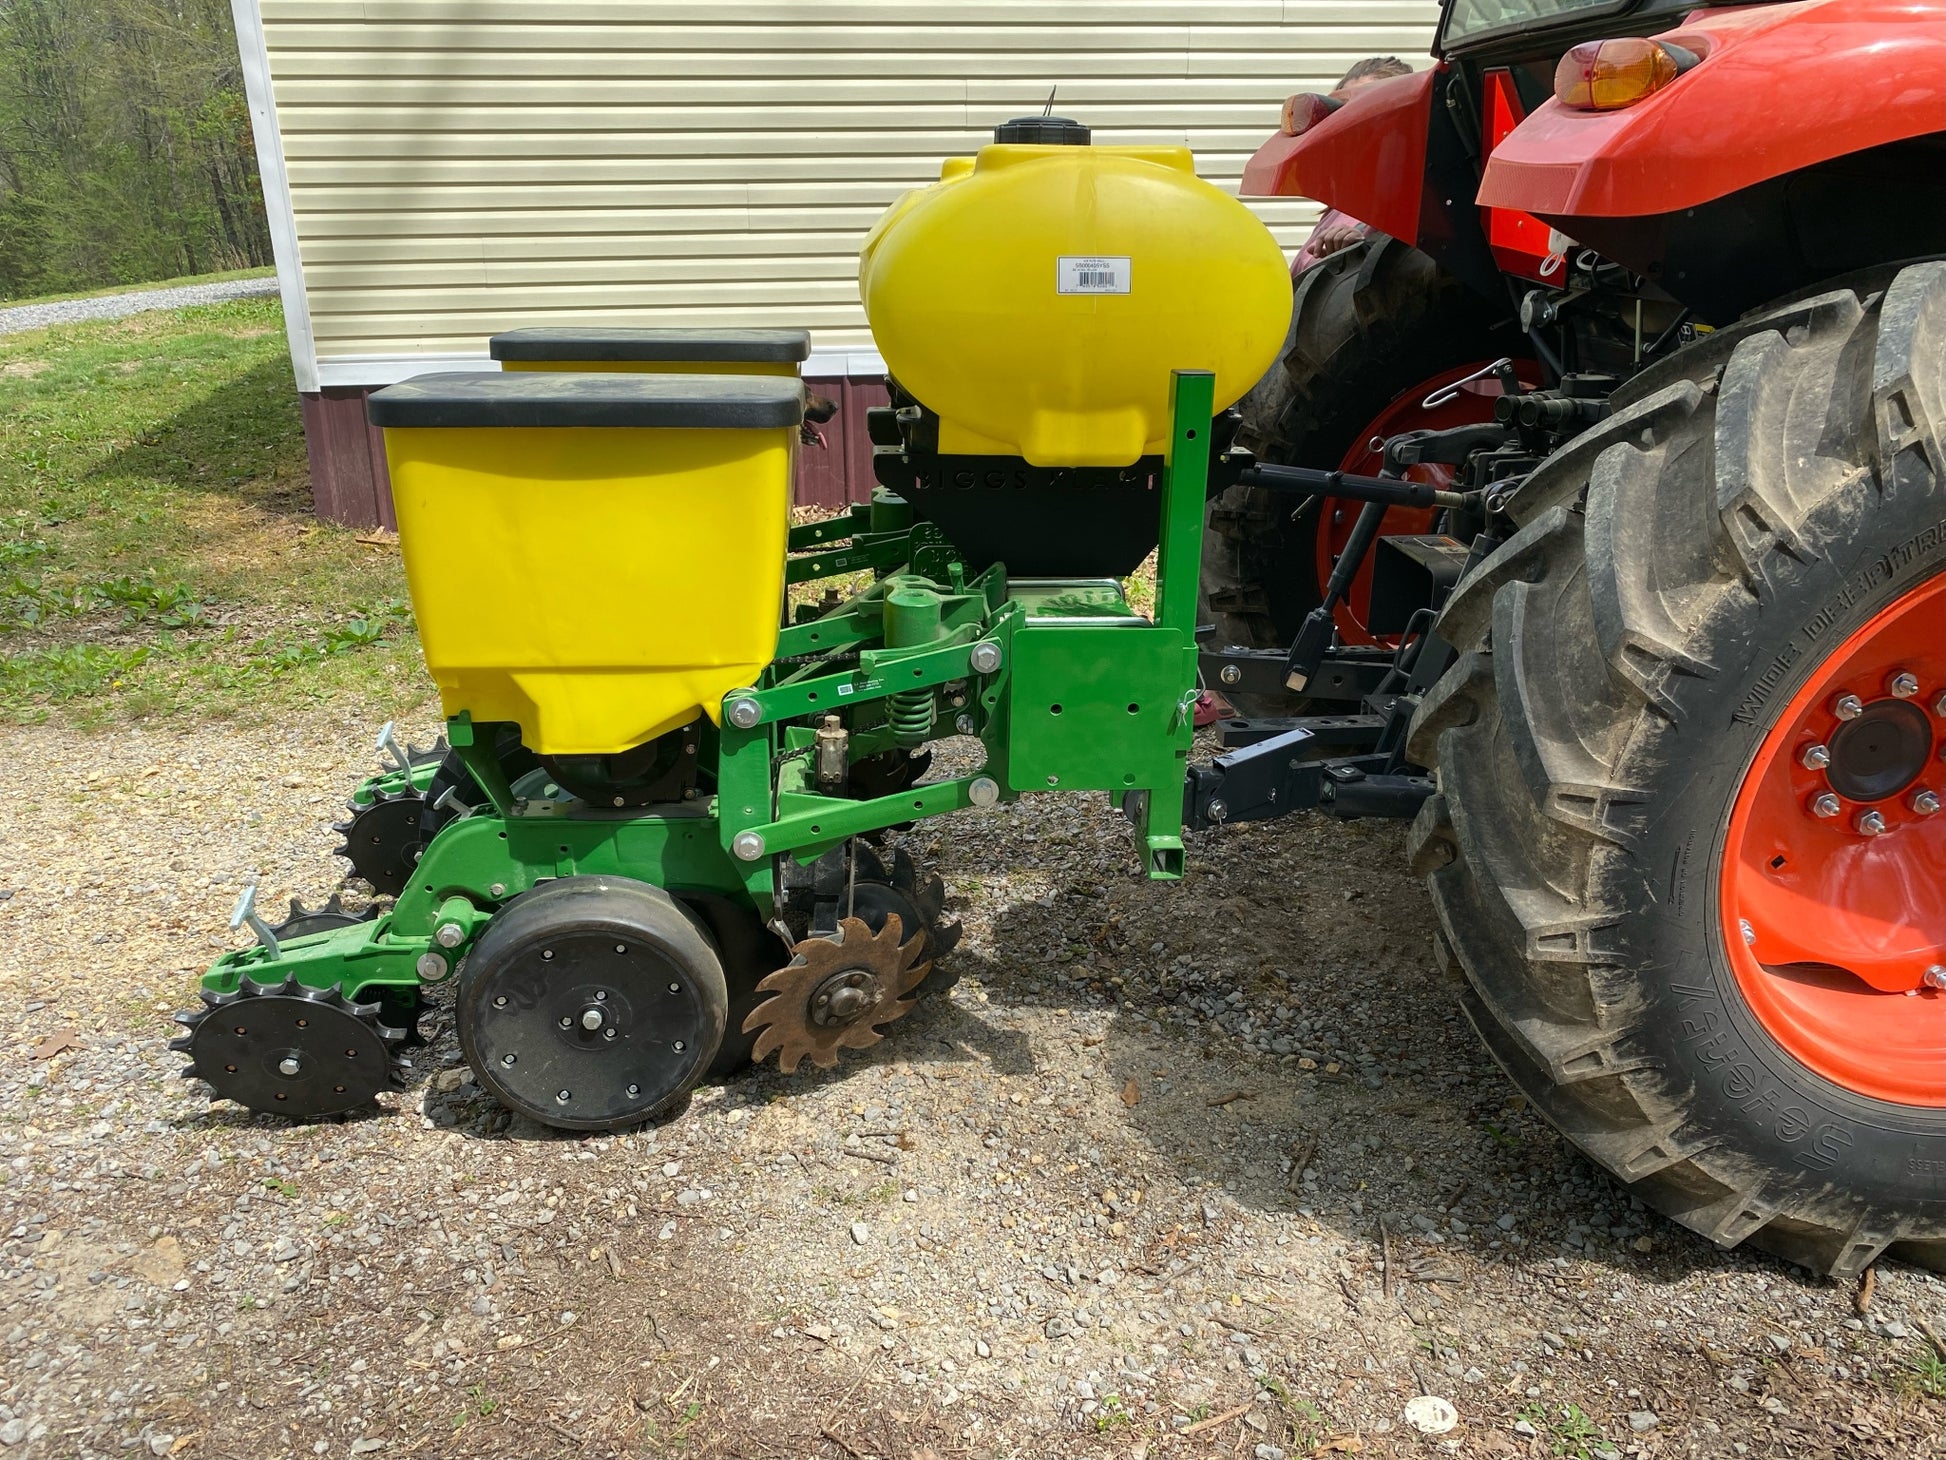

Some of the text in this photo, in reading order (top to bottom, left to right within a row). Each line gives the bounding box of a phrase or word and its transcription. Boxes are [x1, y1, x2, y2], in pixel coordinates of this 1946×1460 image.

[914, 470, 1028, 490] BIGGS
[1734, 641, 1801, 725] WIDE
[1802, 554, 1894, 642] DEEP
